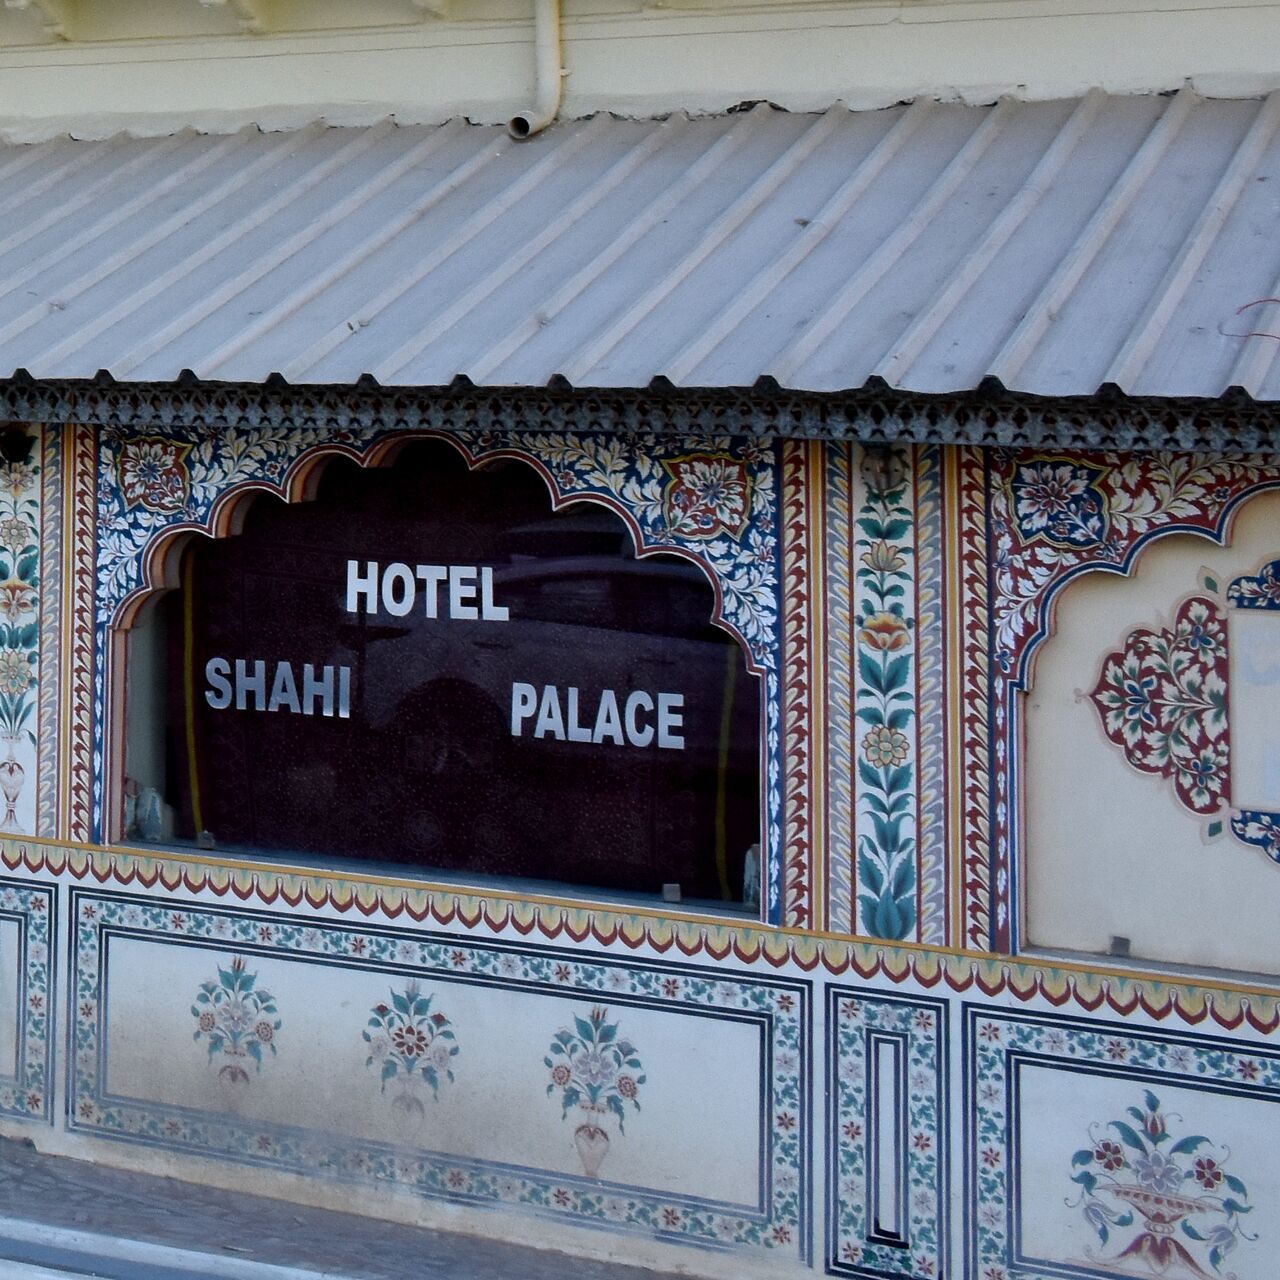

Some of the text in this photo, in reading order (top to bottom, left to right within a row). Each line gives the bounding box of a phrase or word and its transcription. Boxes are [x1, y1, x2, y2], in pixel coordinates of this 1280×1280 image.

[346, 559, 510, 622] HOTEL
[205, 657, 685, 750] SHAHI PALACE
